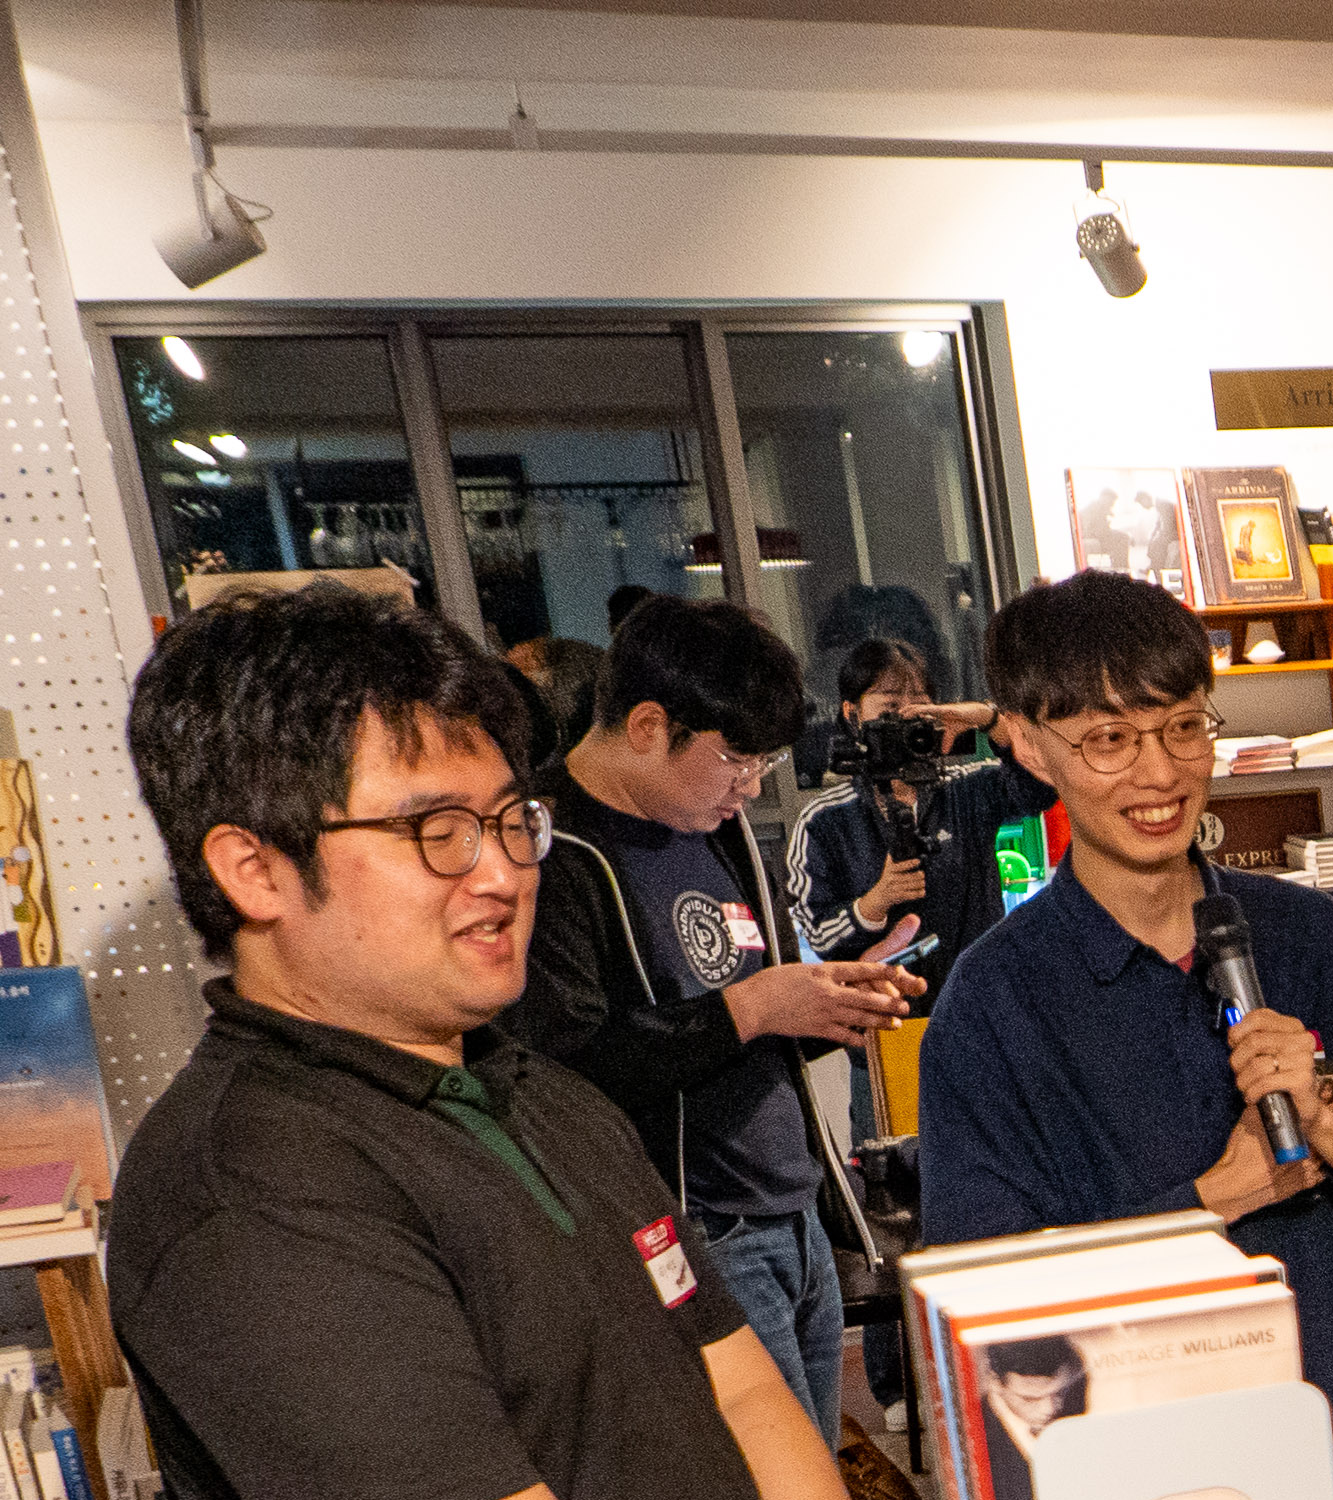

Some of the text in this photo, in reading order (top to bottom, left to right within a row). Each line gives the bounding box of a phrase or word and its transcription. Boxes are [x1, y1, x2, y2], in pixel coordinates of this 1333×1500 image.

[1224, 485, 1269, 495] ARRIVAL
[1094, 1326, 1277, 1368] VINTAGE WILLIAMS
